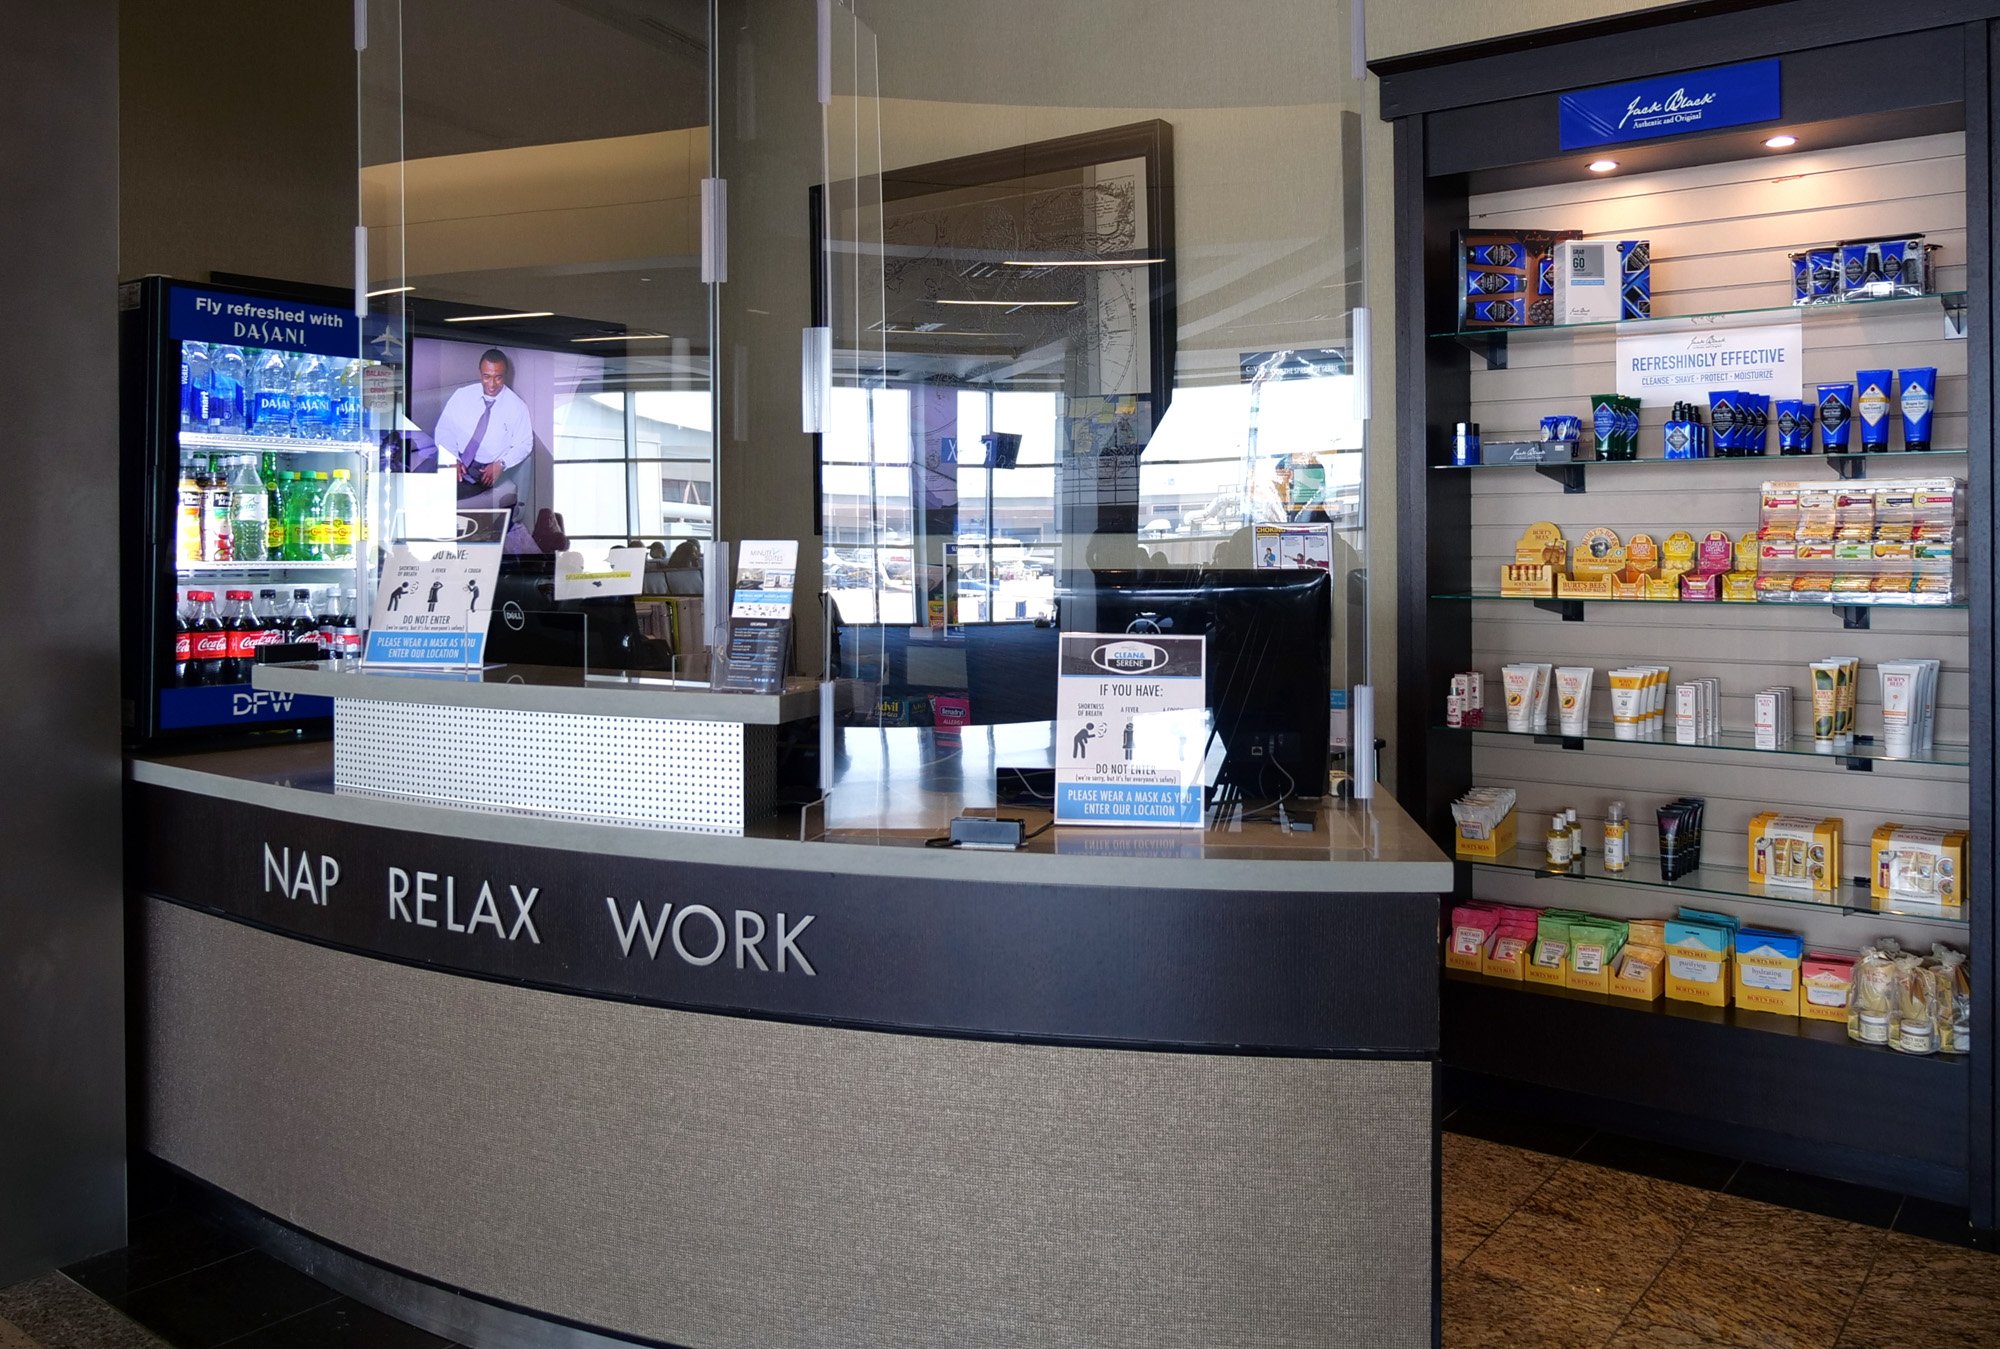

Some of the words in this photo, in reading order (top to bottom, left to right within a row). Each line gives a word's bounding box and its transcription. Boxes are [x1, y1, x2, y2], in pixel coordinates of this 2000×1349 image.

[1618, 96, 1662, 129] Jack
[1633, 118, 1662, 129] Authentic
[1675, 112, 1702, 124] Original
[1572, 257, 1585, 269] GO
[195, 297, 222, 316] Fly
[227, 304, 305, 324] refreshed
[309, 313, 343, 328] with
[233, 321, 306, 345] DASANI
[1632, 352, 1718, 372] REFRESHINGLY
[1721, 348, 1785, 366] EFFECTIVE
[1642, 376, 1670, 386] CLEANSE
[1674, 375, 1695, 384] SHAVE
[1700, 373, 1728, 382] PROTECT
[1734, 370, 1773, 380] MOISTURIZE
[403, 615, 413, 625] DO
[415, 615, 428, 625] NOT
[430, 615, 451, 625] ENTER
[377, 637, 401, 647] PLEASE
[403, 637, 421, 647] WEAR
[423, 638, 428, 647] A
[429, 638, 448, 648] MASK
[449, 638, 459, 648] AS
[460, 638, 476, 648] YOU
[388, 649, 408, 658] ENTER
[411, 649, 425, 659] OUR
[426, 649, 459, 659] LOCATION
[1100, 684, 1109, 696] IF
[1112, 684, 1132, 697] YOU
[1136, 685, 1164, 697] HAVE:
[233, 691, 294, 716] DFW
[875, 701, 899, 712] Advil
[941, 708, 965, 716] Benadryl
[1096, 764, 1108, 774] DO
[1111, 764, 1128, 775] NOT
[1068, 789, 1097, 801] PLEASE
[1100, 790, 1124, 801] WEAR
[1126, 791, 1133, 802] A
[1135, 791, 1159, 803] MASK
[1162, 792, 1172, 803] AS
[1174, 792, 1192, 804] YOU
[1084, 803, 1110, 815] ENTER
[1112, 804, 1131, 815] OUR
[1133, 804, 1175, 816] LOCATION
[263, 842, 340, 906] NAP
[389, 866, 540, 944] RELAX
[606, 896, 817, 977] WORK
[1751, 967, 1782, 978] hydrating
